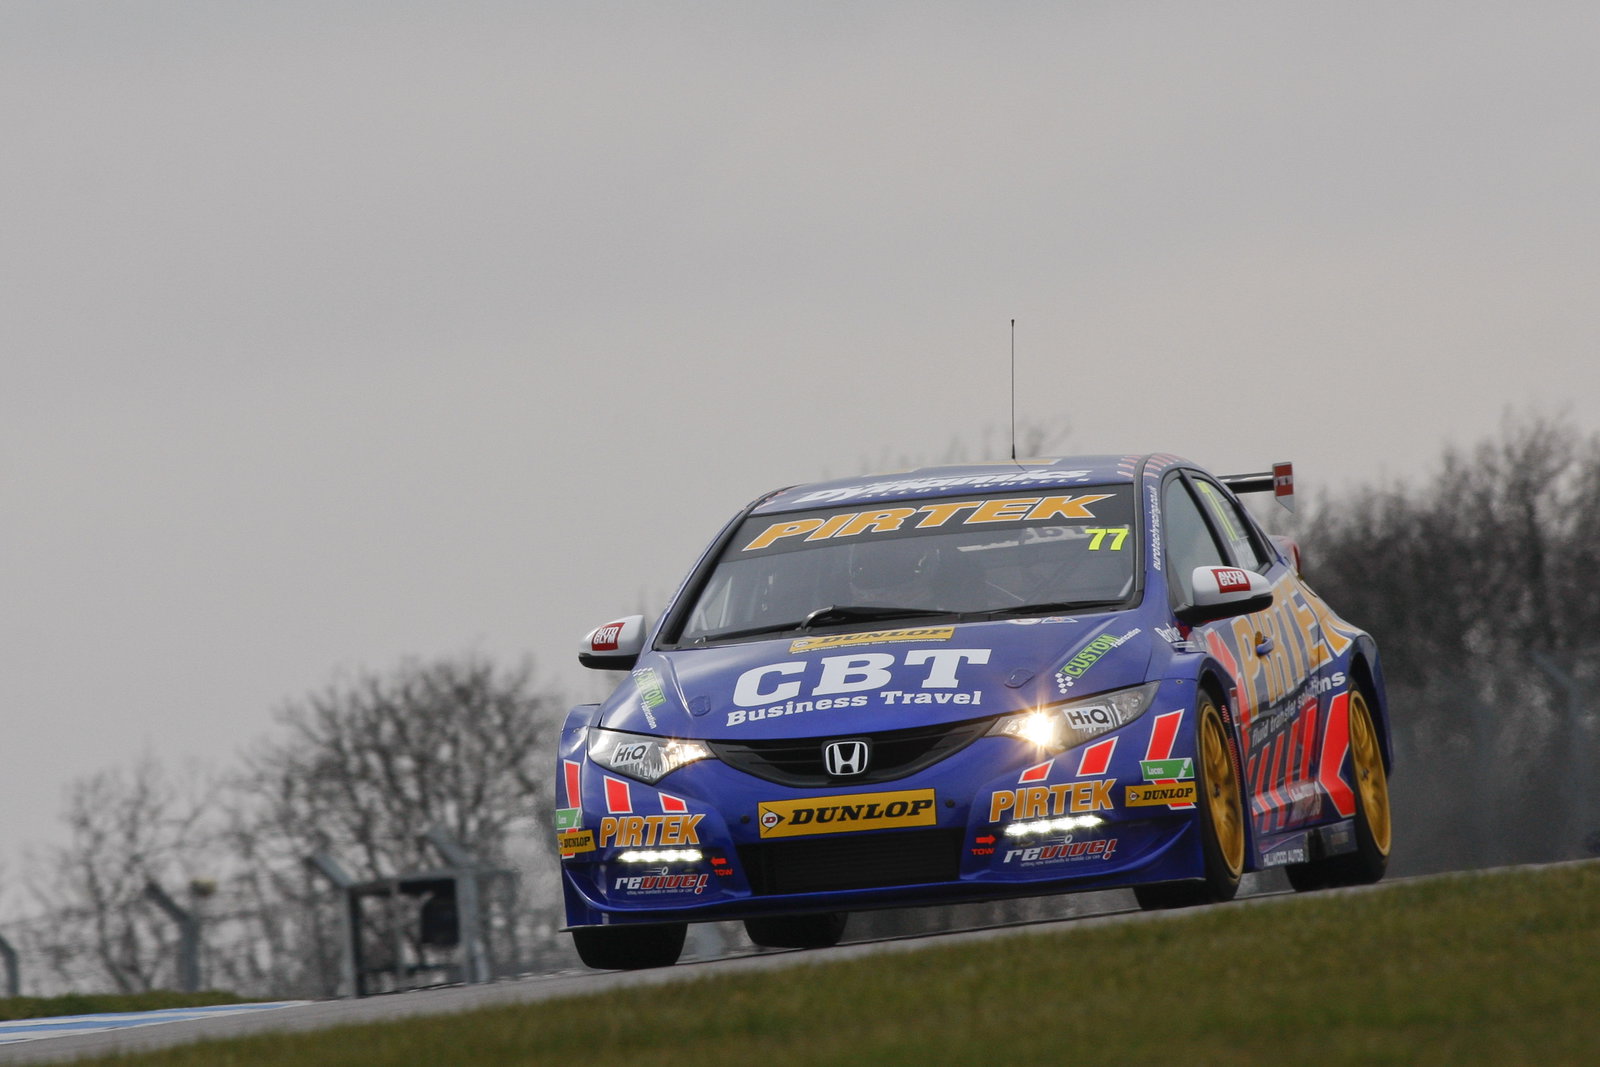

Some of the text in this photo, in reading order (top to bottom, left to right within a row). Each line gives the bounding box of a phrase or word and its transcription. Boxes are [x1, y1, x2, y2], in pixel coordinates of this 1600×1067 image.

[742, 493, 1117, 552] PIRTEK
[1085, 528, 1129, 550] 77
[1218, 571, 1243, 579] AUTO
[1220, 576, 1247, 586] GLYM
[820, 629, 952, 643] DUNLOP
[1064, 634, 1117, 676] CUSTOM
[732, 649, 992, 707] CBT
[726, 691, 982, 727] Business Travel
[1067, 708, 1110, 726] HiQ
[615, 745, 647, 763] HiQ
[989, 778, 1118, 823] PIRTEK
[1143, 788, 1193, 800] DUNLOP
[788, 799, 934, 825] DUNLOP
[600, 813, 706, 848] PIRTEK
[564, 836, 591, 848] DUNLOP
